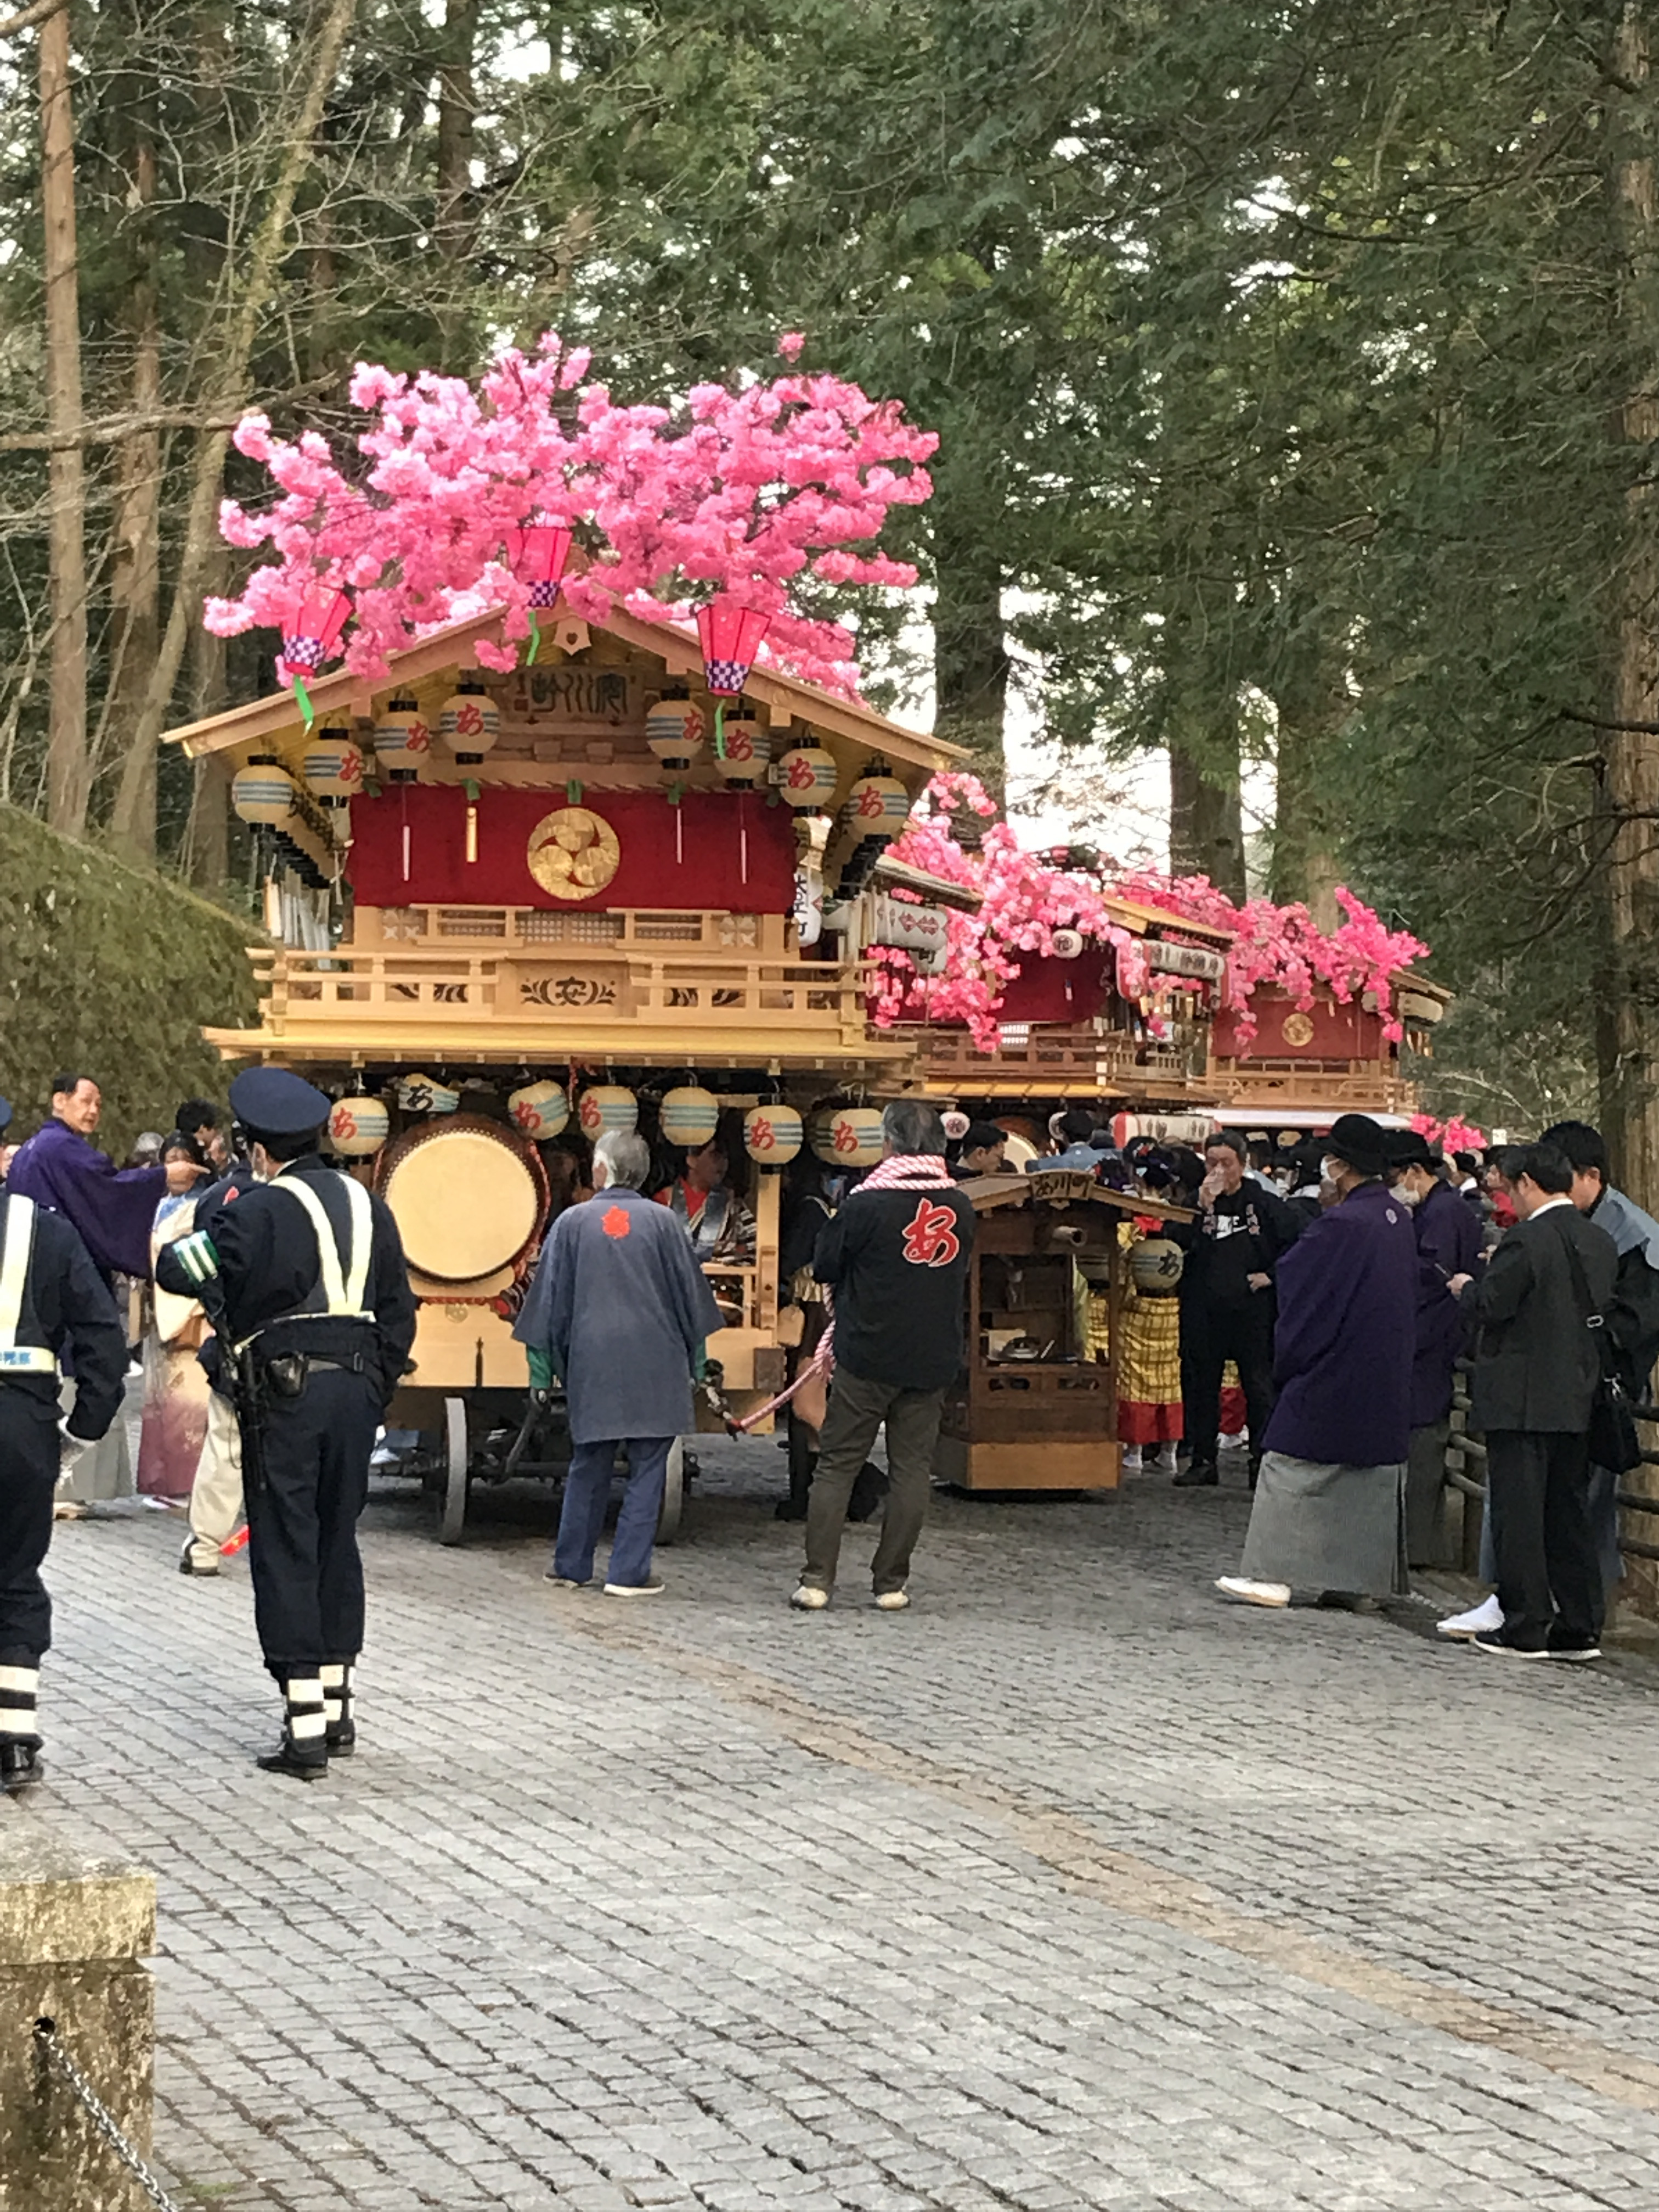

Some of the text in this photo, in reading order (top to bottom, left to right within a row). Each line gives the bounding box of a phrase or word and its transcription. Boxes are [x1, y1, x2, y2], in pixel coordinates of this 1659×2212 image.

[458, 702, 483, 736] あ
[683, 709, 705, 741] あ
[406, 720, 428, 753] あ
[726, 729, 753, 761] あ
[788, 757, 815, 790] あ
[858, 785, 884, 819] あ
[406, 1083, 433, 1111] あ
[580, 1096, 602, 1128] あ
[332, 1107, 358, 1141] あ
[515, 1101, 543, 1130] あ
[751, 1116, 776, 1150] あ
[834, 1120, 859, 1153] あ
[901, 1197, 960, 1267] あ
[1158, 1249, 1180, 1278] あ
